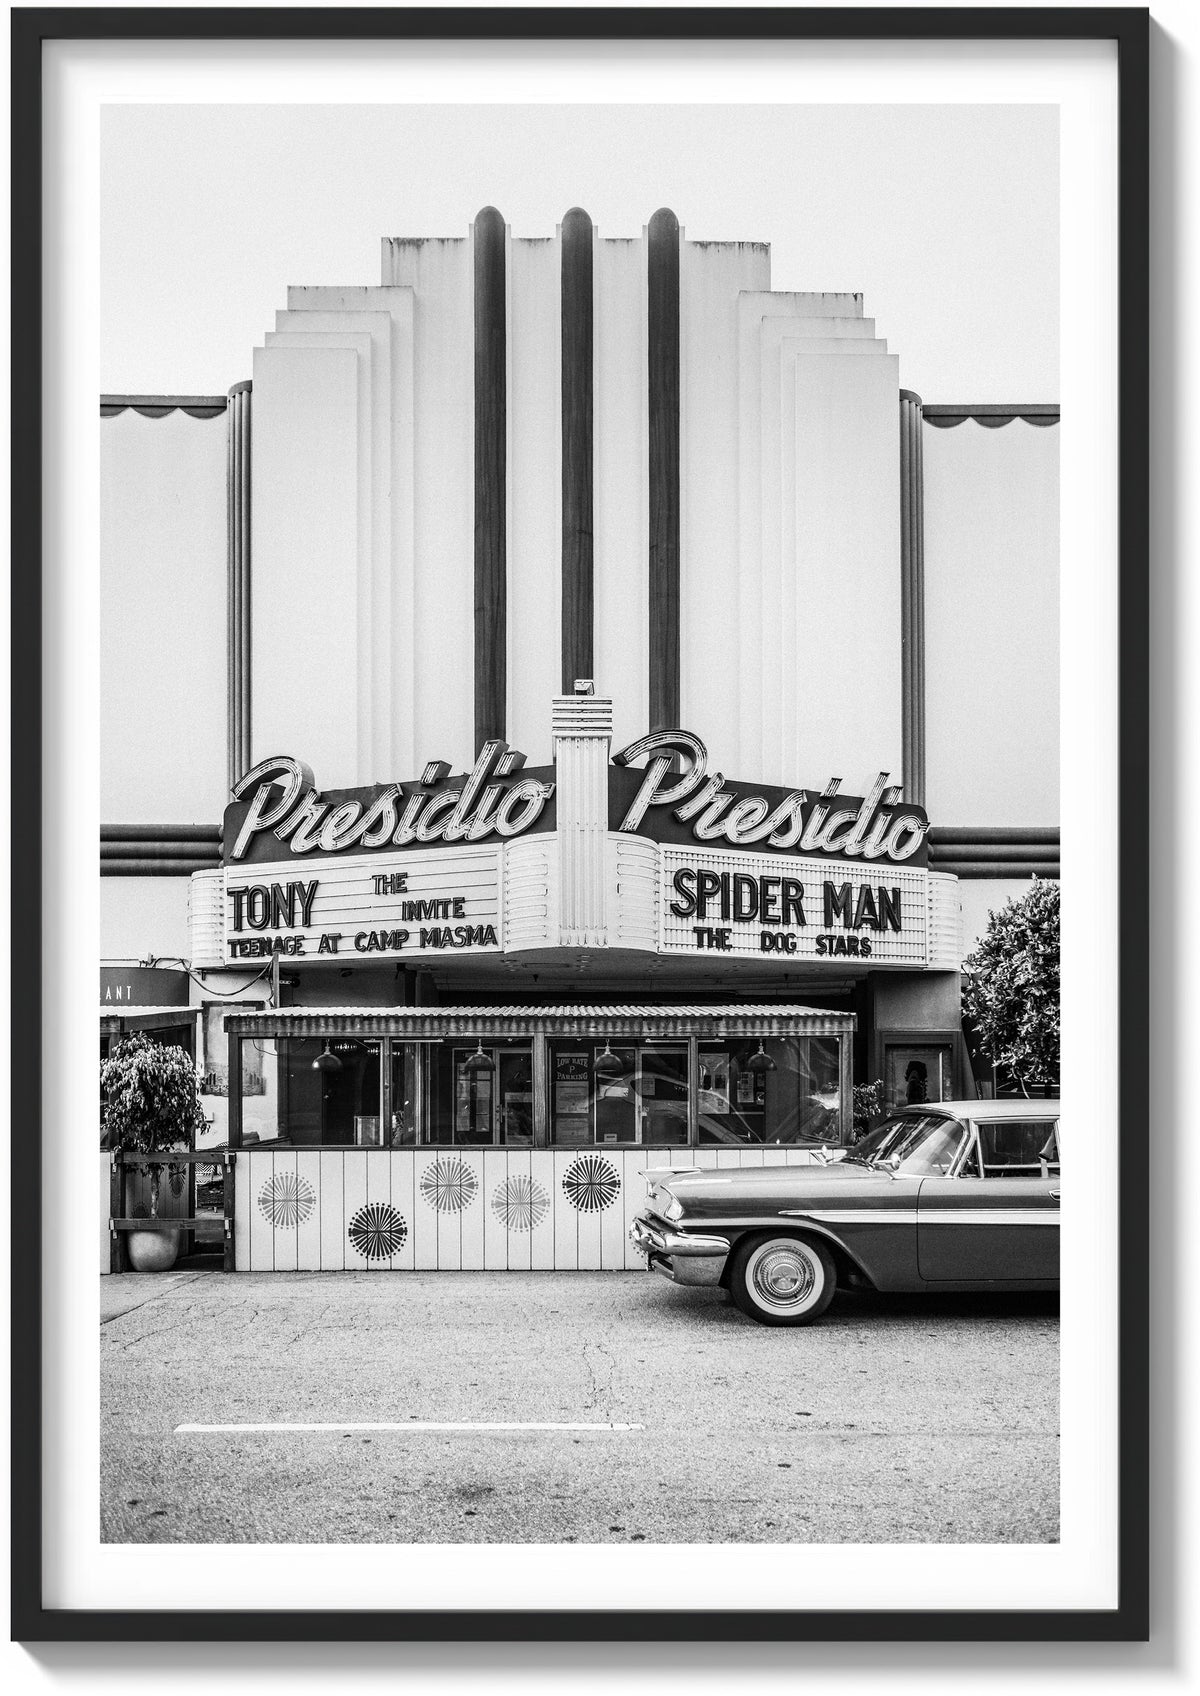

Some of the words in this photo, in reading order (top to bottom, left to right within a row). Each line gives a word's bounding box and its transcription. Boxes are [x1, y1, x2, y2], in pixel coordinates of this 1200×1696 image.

[231, 739, 556, 860] Presidio
[611, 728, 930, 861] Presidio
[371, 872, 409, 896] THE
[670, 867, 806, 927] SPIDER
[823, 880, 901, 932] MAN
[227, 879, 319, 933] TONY
[401, 897, 465, 922] INVITE
[227, 935, 306, 958] TEENAGE
[317, 933, 341, 954] AT
[354, 929, 409, 952] CAMP
[419, 924, 498, 948] MIASMA
[694, 926, 732, 950] THE
[760, 930, 797, 953] DOG
[815, 934, 872, 957] STARS
[99, 985, 132, 1000] ANT
[556, 1072, 588, 1080] PARKING
